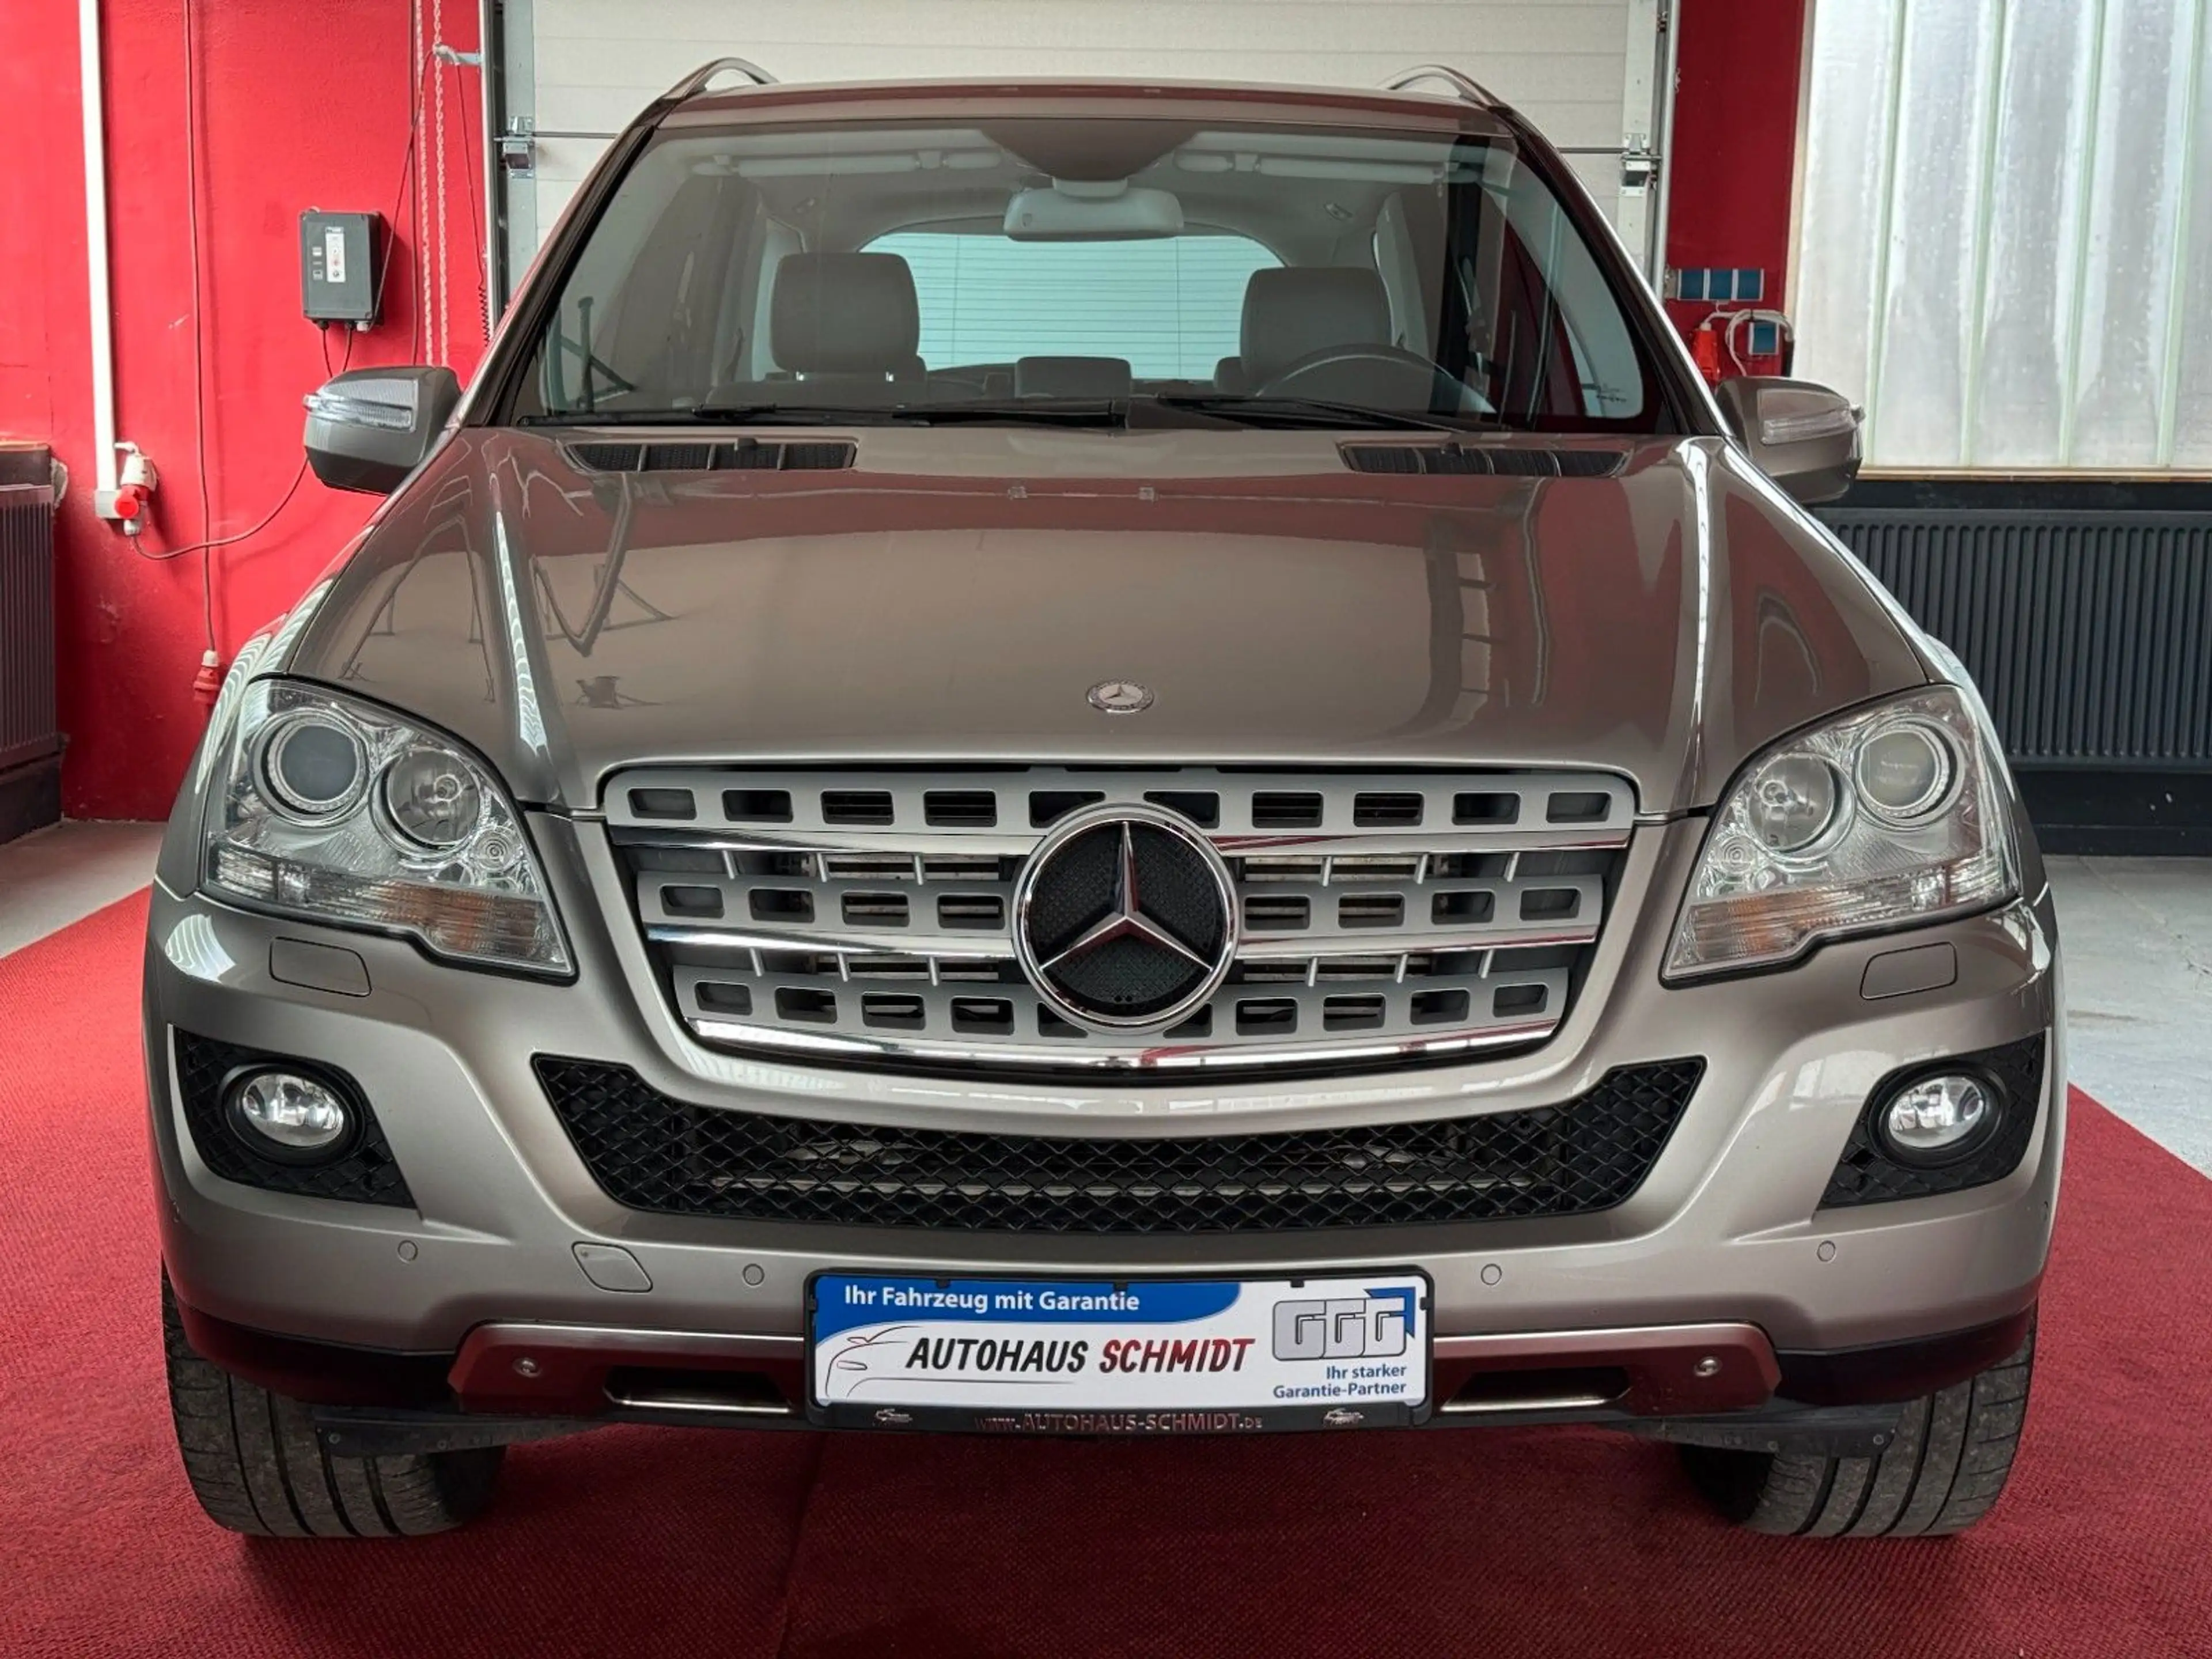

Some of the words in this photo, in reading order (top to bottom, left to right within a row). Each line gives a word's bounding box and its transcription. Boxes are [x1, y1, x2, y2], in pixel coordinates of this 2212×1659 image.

[844, 1285, 876, 1305] Ihr
[882, 1287, 988, 1313] Fahrzeug
[995, 1290, 1033, 1310] mit
[1039, 1291, 1140, 1311] Garantie
[905, 1338, 1088, 1373] AUTOHAUS
[1099, 1338, 1256, 1374] SCHMIDT
[1326, 1365, 1349, 1379] Ihr
[1351, 1363, 1407, 1378] starker
[1272, 1383, 1407, 1399] Garantie-Partner
